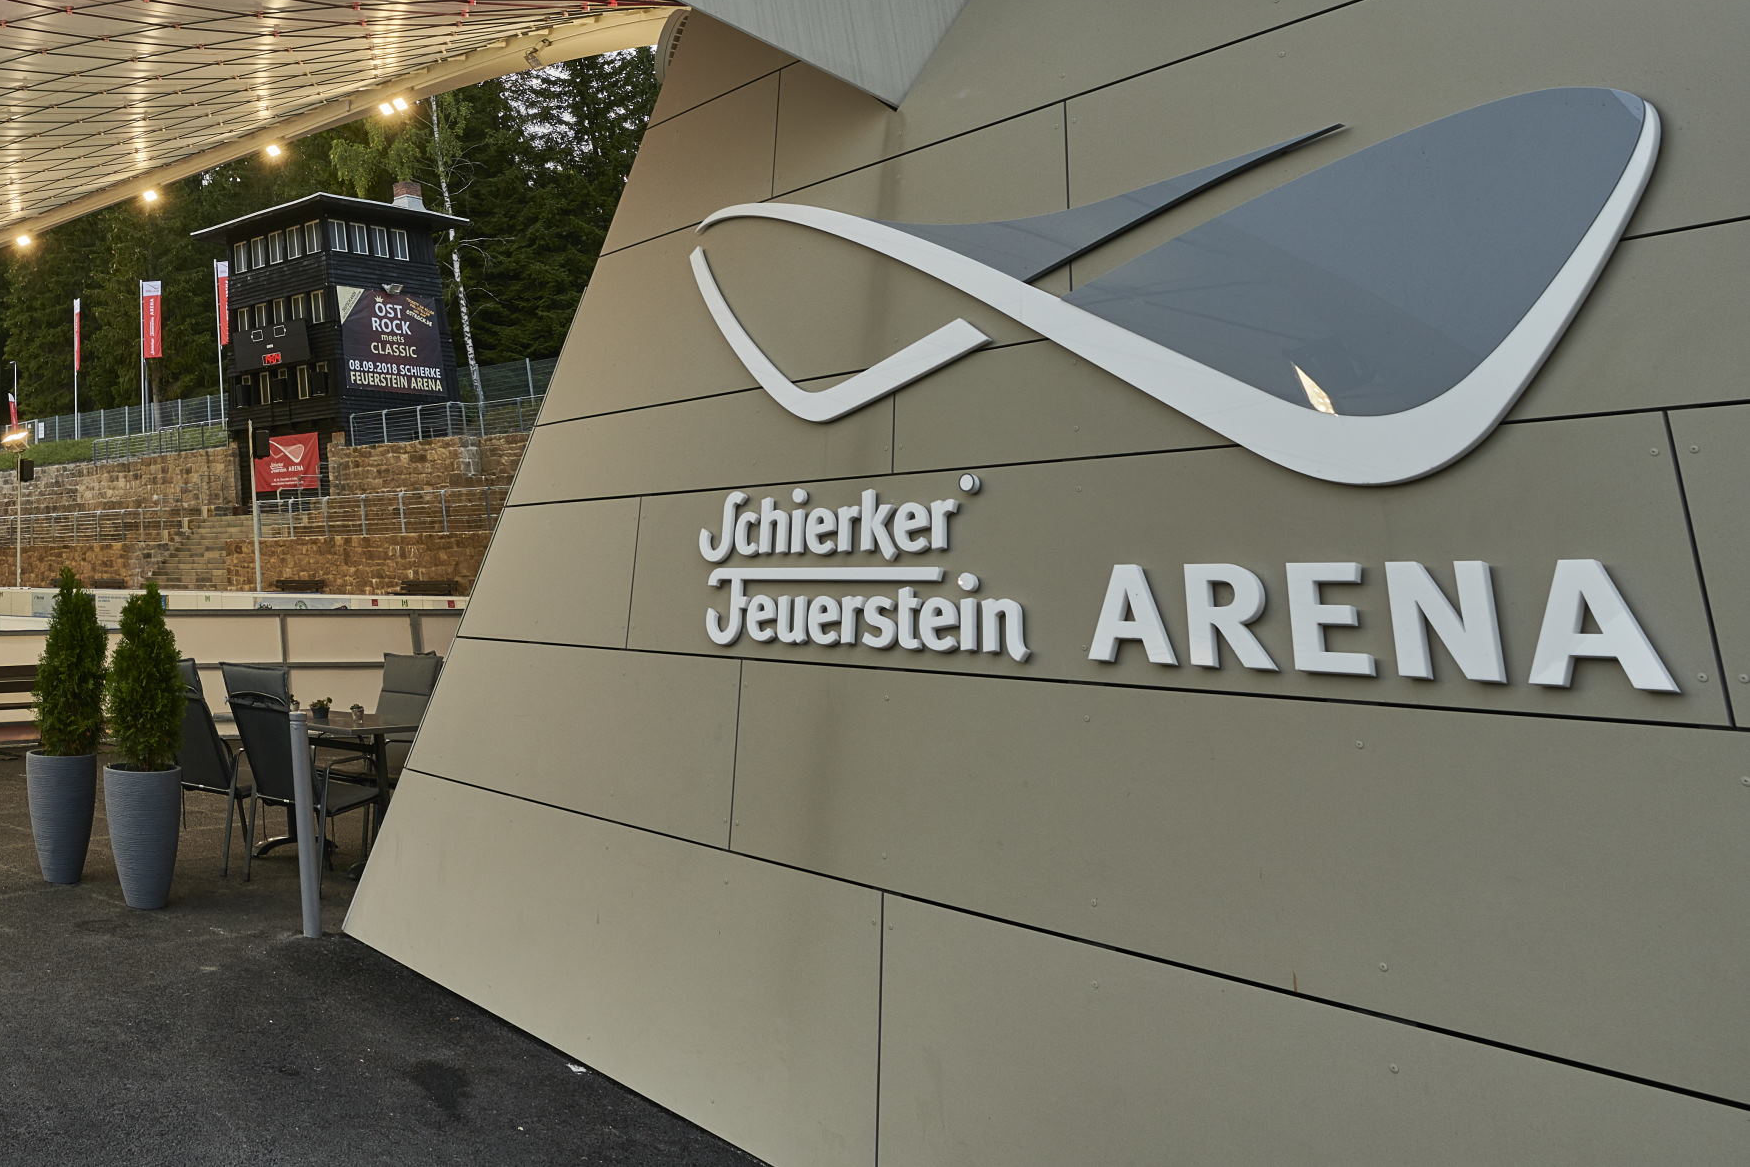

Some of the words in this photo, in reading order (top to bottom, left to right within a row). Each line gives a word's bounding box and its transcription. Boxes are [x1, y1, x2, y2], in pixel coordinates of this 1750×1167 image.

[375, 302, 403, 319] OST
[371, 317, 412, 335] ROCK
[381, 334, 405, 343] meets
[370, 342, 418, 358] CLASSIC
[349, 359, 398, 375] 08.09.2018
[400, 364, 442, 379] SCHIERKE
[350, 371, 409, 389] FEUERSTEIN
[410, 377, 443, 392] ARENA
[699, 488, 960, 564] Schierker
[1087, 558, 1683, 695] ARENA
